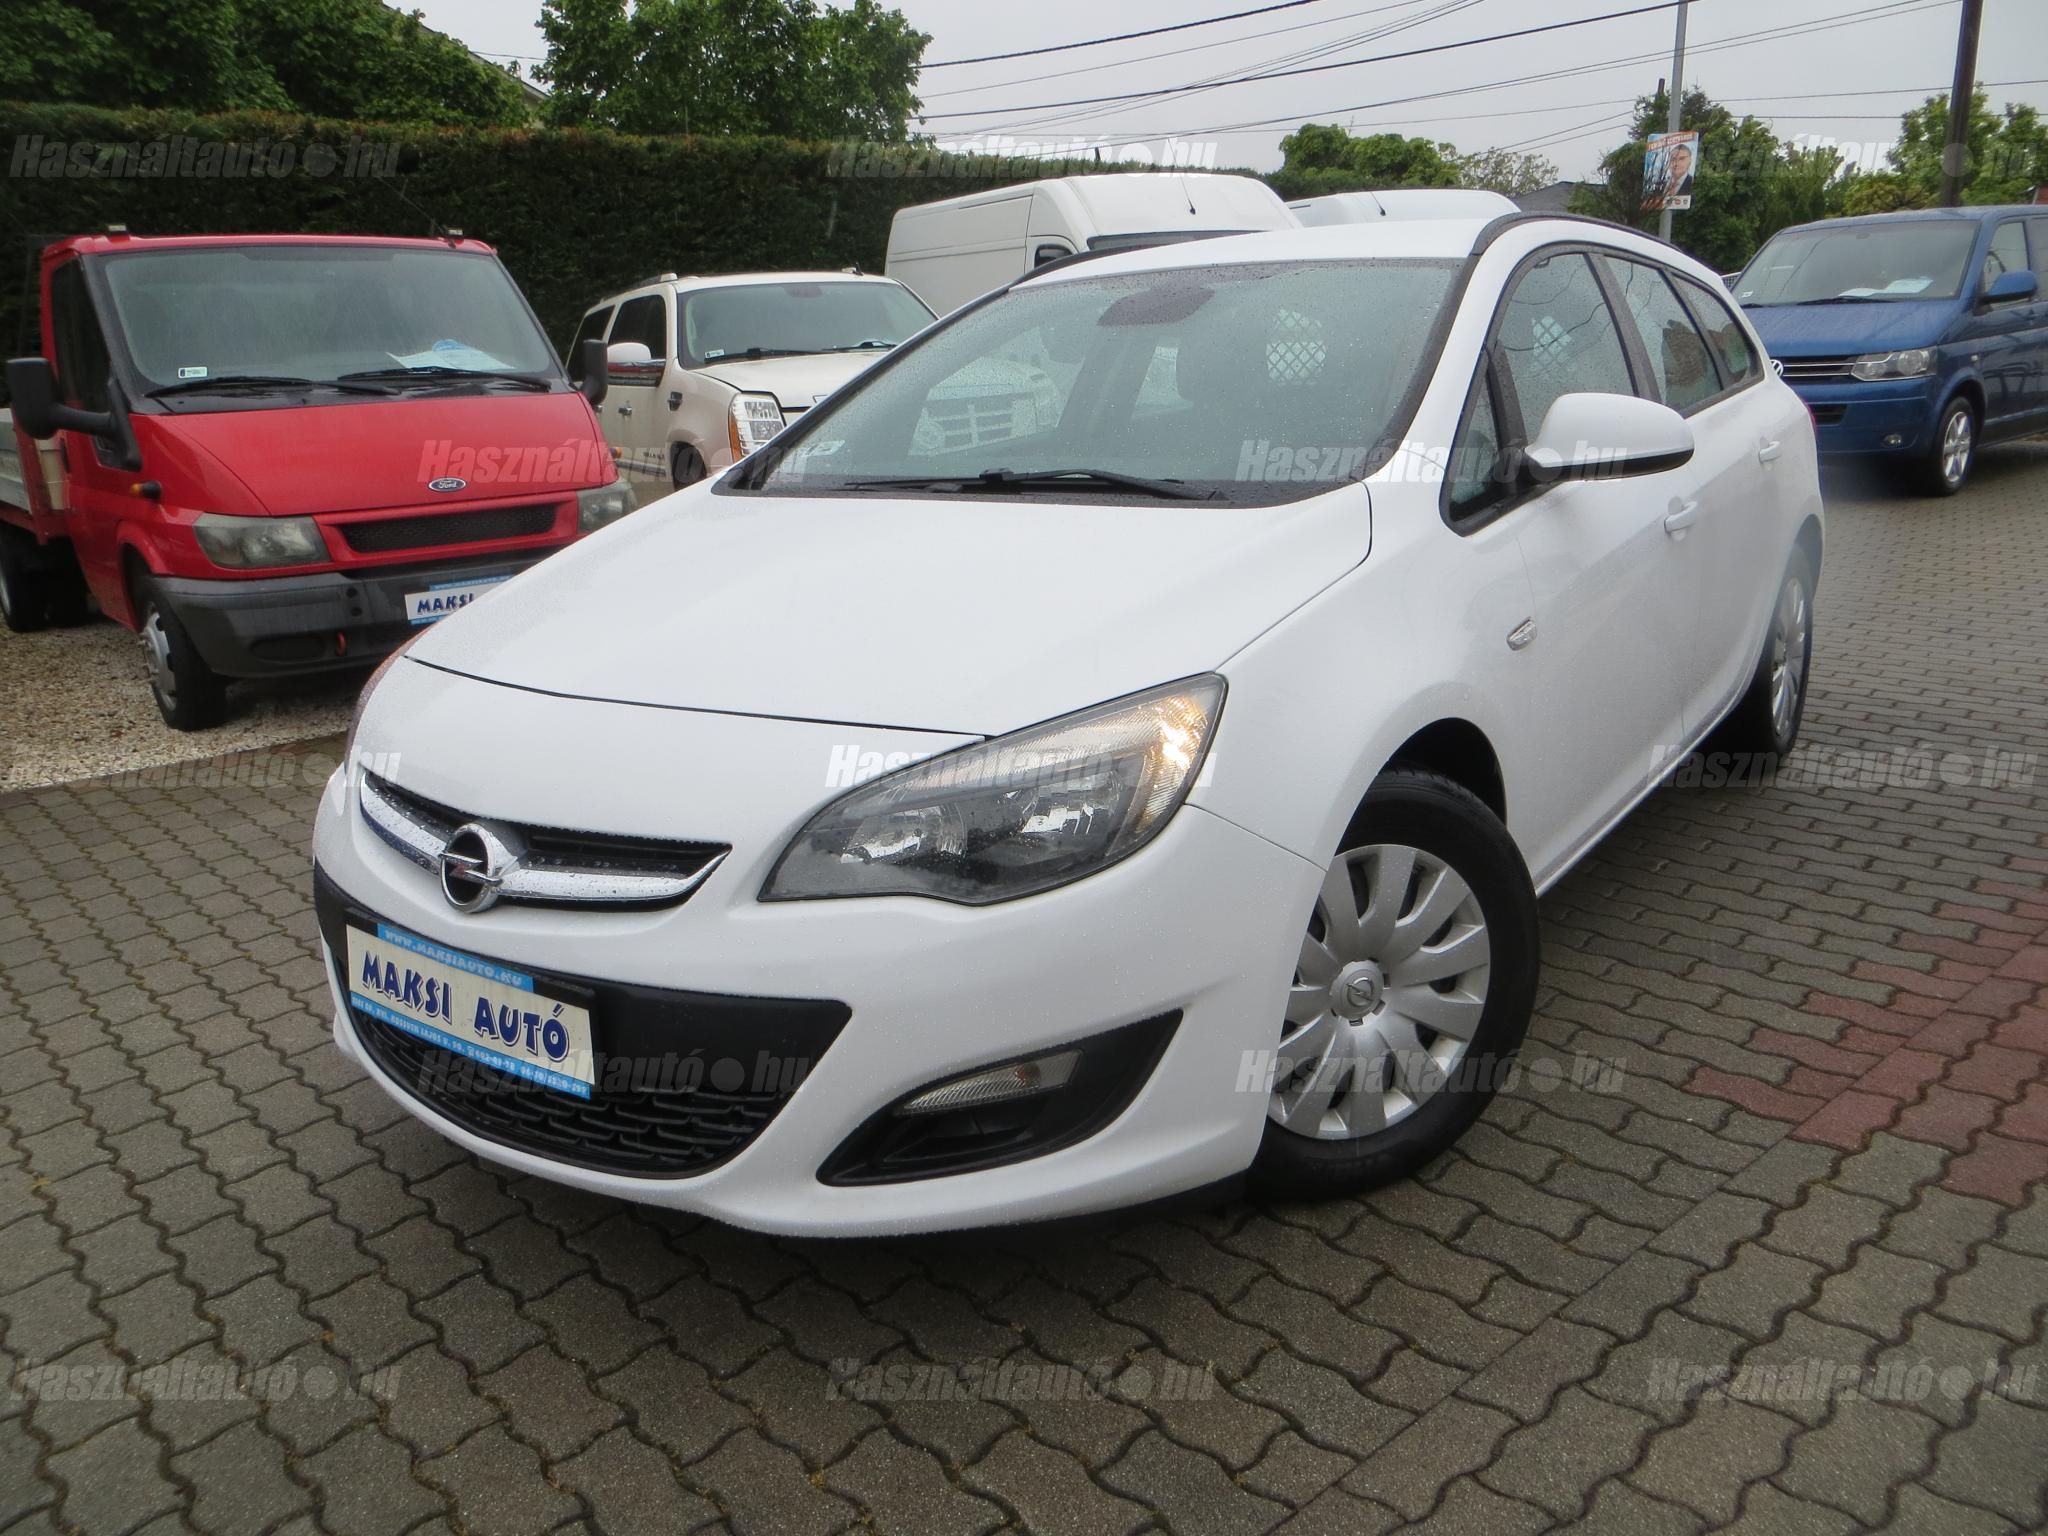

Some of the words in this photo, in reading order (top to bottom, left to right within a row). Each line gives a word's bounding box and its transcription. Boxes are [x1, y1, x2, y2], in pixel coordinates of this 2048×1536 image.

[417, 593, 474, 614] MAKSI
[362, 951, 452, 1024] MAKSI
[473, 997, 571, 1062] AUTÓ
